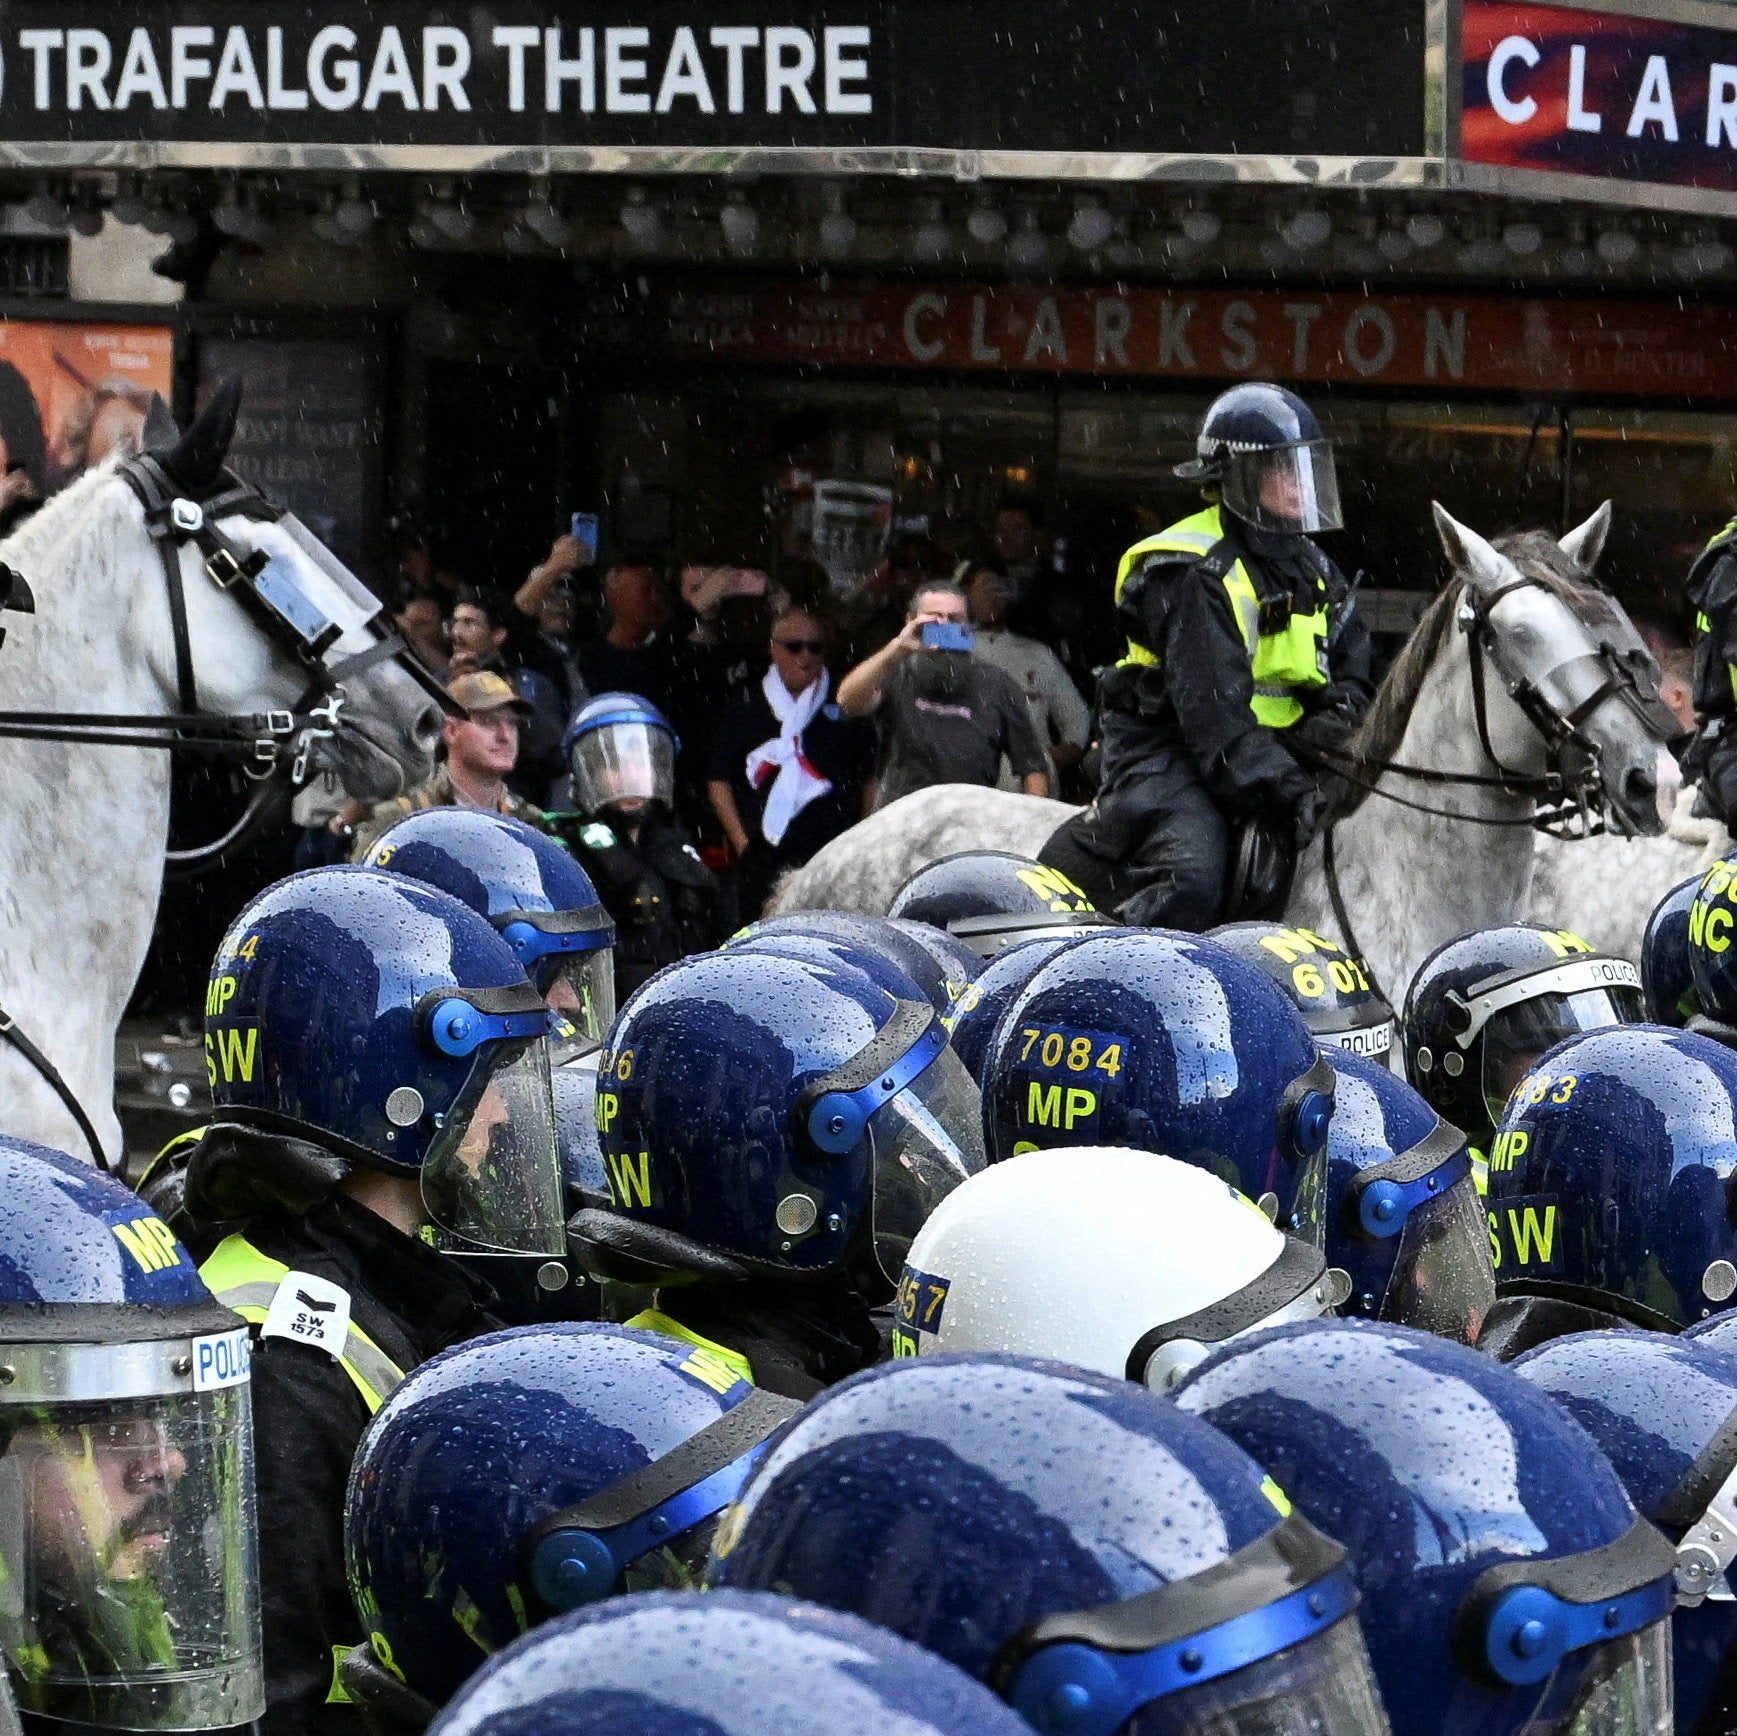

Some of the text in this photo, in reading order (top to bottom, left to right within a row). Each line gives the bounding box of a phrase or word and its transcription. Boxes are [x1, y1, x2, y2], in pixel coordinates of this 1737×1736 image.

[19, 25, 874, 116] TRAFALGAR THEATRE
[902, 292, 1467, 379] CLARKSTON
[1020, 1029, 1123, 1079] 7084
[1340, 1029, 1390, 1057] POLICE
[1027, 1081, 1097, 1130] MP
[1490, 1131, 1529, 1172] MP
[112, 1217, 182, 1275] MP
[290, 1323, 325, 1340] 1573
[296, 1312, 325, 1328] SW
